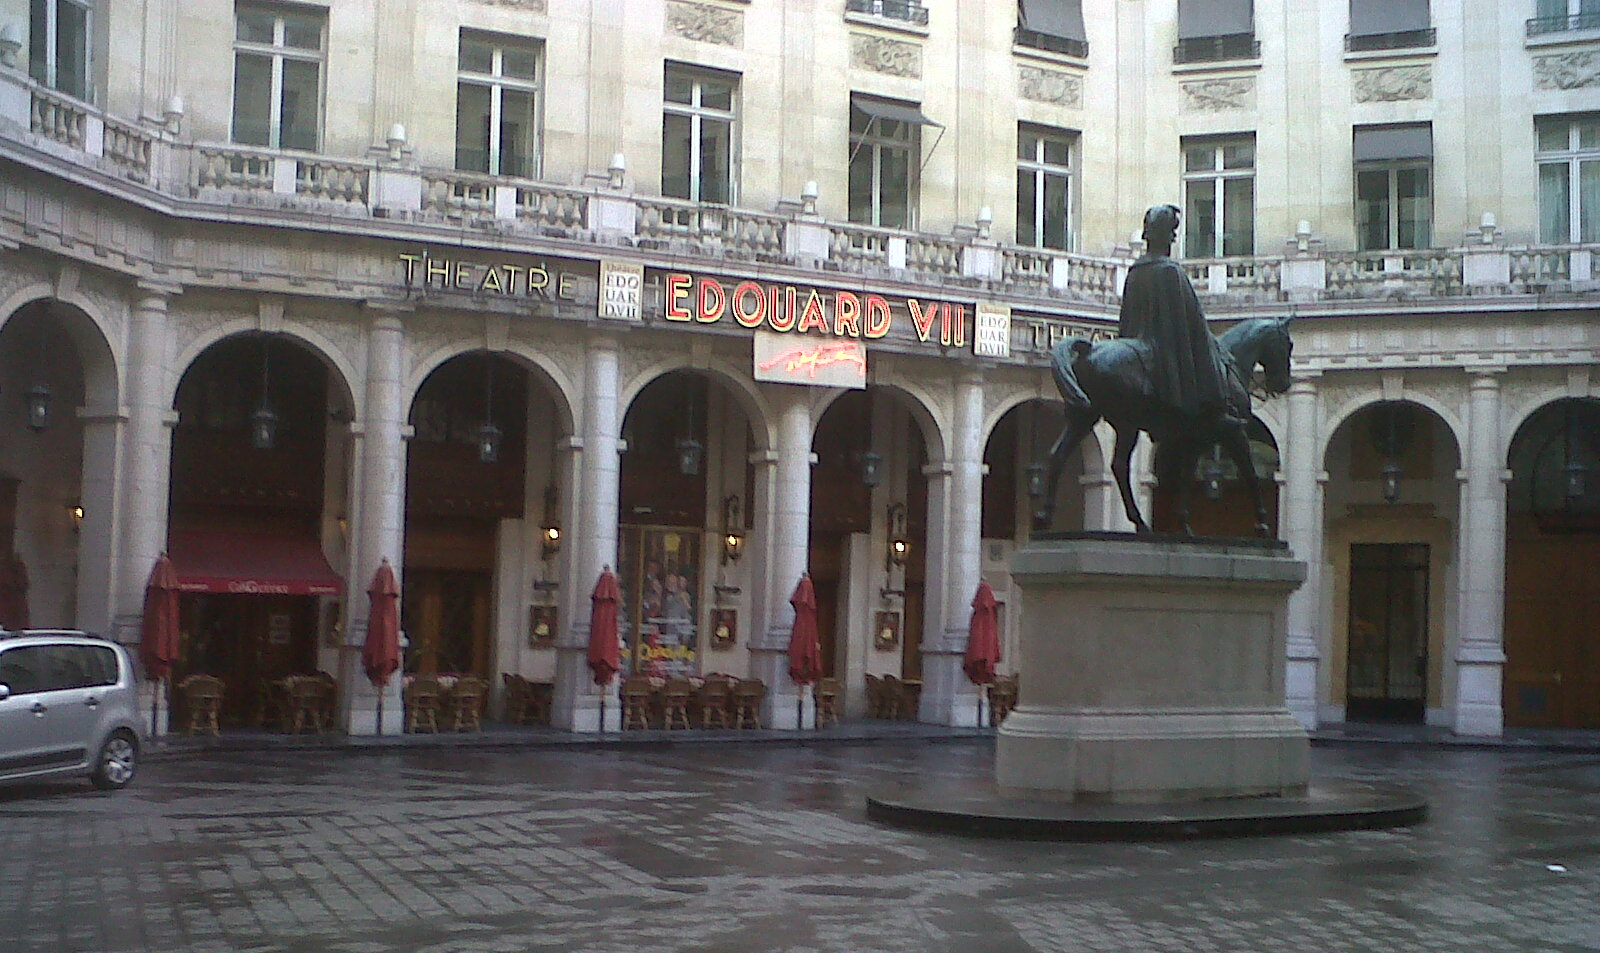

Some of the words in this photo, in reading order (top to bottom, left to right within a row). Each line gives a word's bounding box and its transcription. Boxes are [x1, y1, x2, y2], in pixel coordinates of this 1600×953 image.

[400, 253, 577, 299] THEATRE
[606, 274, 639, 289] EDO
[606, 289, 637, 304] UAR
[664, 274, 891, 339] EDOUARD
[907, 299, 965, 347] VII
[980, 315, 1007, 329] EDO
[980, 329, 1006, 343] UAR
